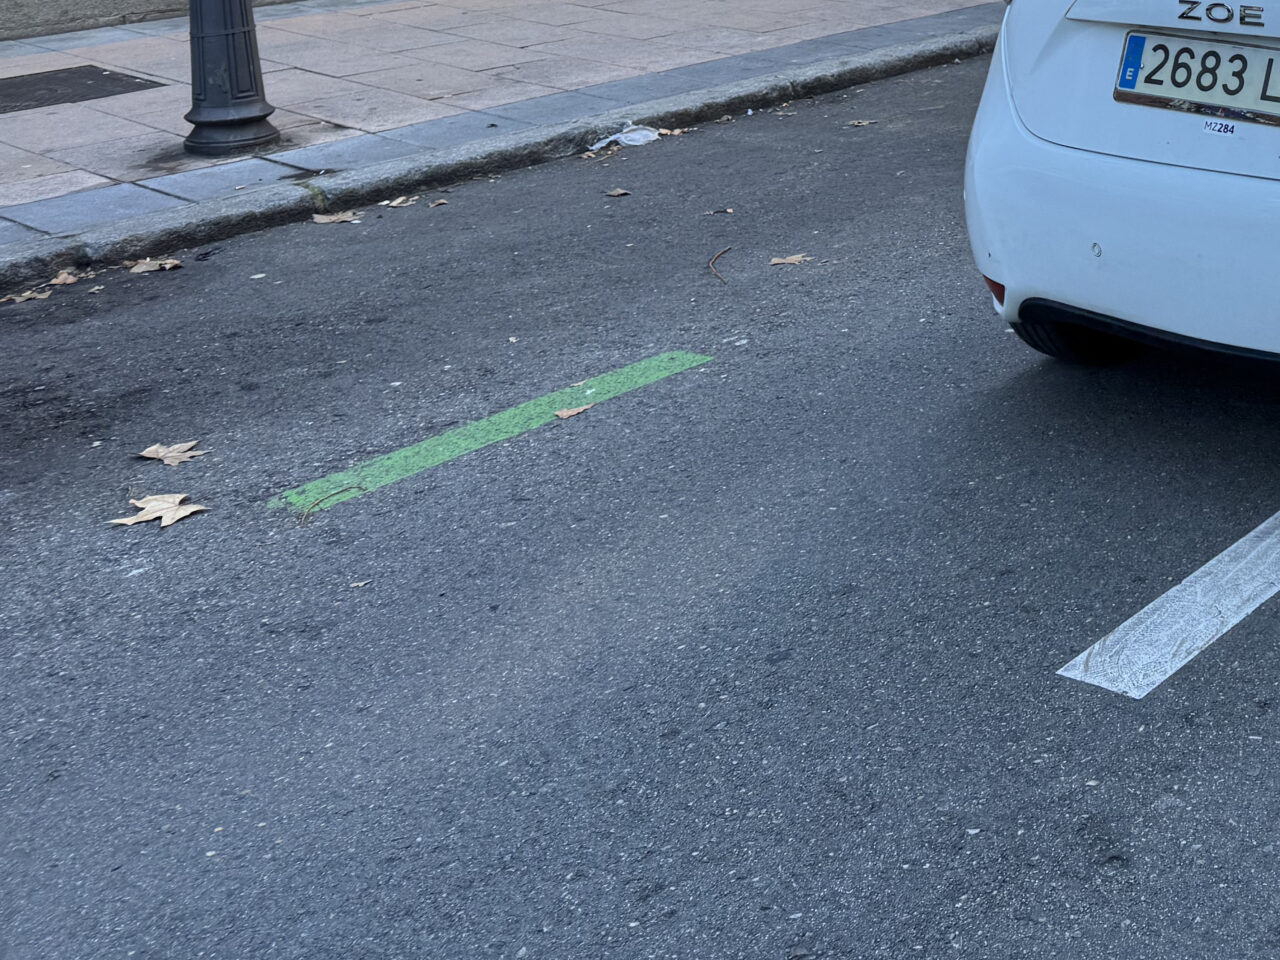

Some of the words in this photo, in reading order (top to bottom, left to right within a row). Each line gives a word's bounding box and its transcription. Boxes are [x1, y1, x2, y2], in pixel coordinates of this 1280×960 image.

[1178, 0, 1265, 27] ZOE
[1126, 68, 1134, 80] E
[1143, 43, 1249, 96] 2683
[1203, 120, 1235, 135] MZ284
